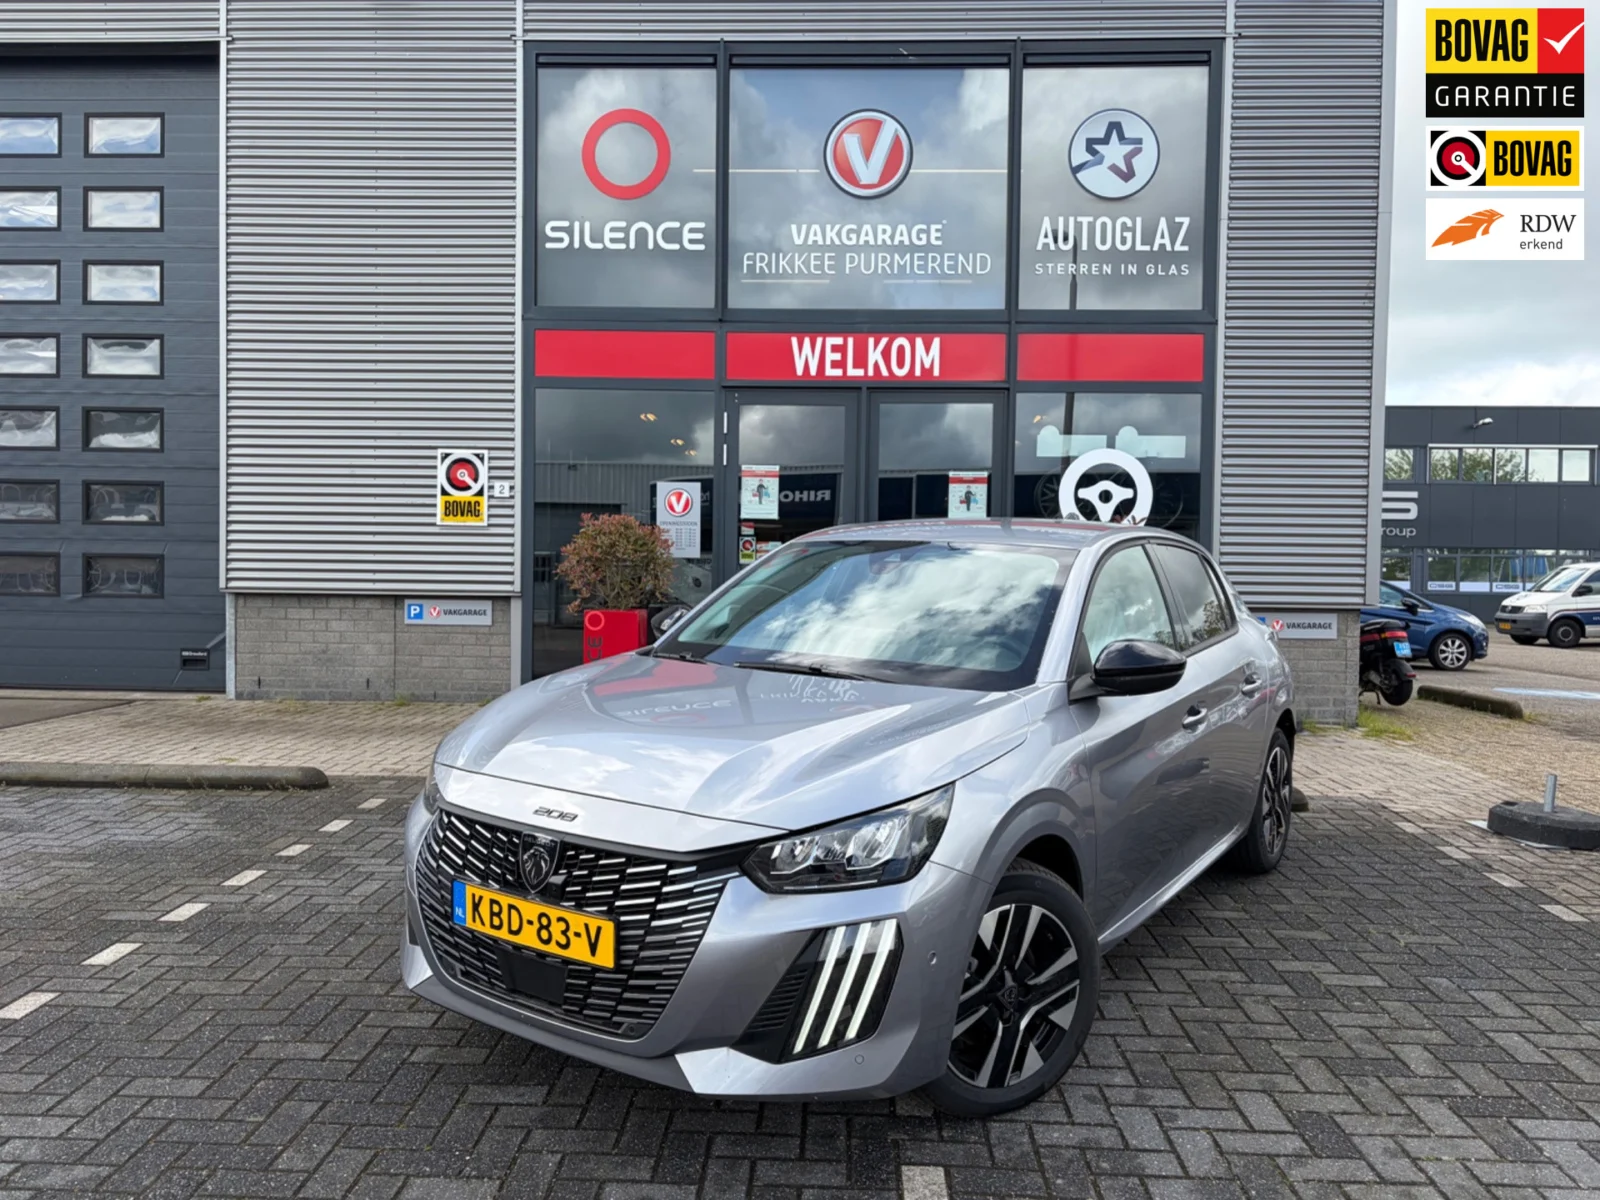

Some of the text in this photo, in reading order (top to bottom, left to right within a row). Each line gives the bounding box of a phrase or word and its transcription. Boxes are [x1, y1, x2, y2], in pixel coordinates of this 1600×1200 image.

[545, 220, 706, 251] SILENCE
[791, 223, 943, 246] VAKGARAGE
[1036, 216, 1191, 251] AUTOGLAZ
[743, 252, 991, 275] FRIKKEE PURMEREND
[1035, 263, 1190, 275] STERREN IN GLAS
[791, 336, 941, 377] WELKOM
[499, 484, 505, 494] 2
[444, 500, 480, 517] BOVAG
[443, 608, 487, 617] VAKGARAGE
[1286, 622, 1333, 630] VAKGARAGE
[532, 806, 579, 822] 208
[455, 906, 465, 918] NL
[472, 892, 603, 958] KBD-83-V
